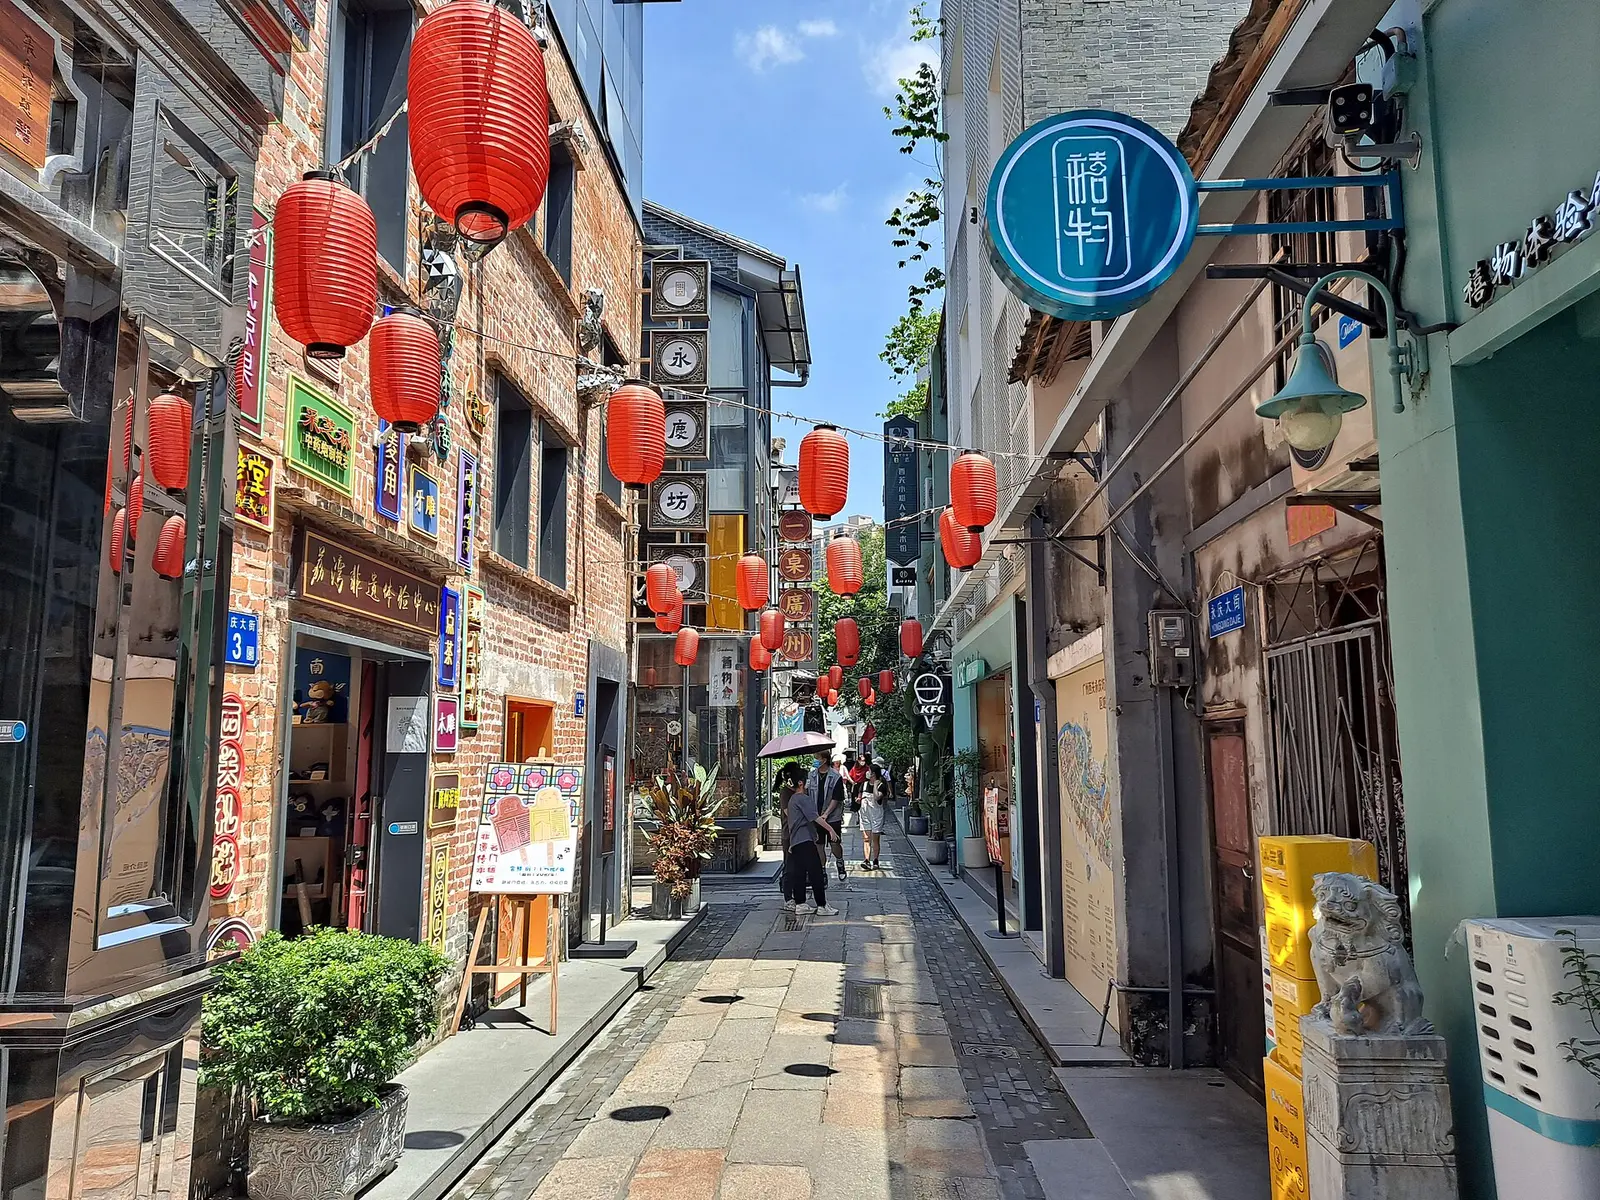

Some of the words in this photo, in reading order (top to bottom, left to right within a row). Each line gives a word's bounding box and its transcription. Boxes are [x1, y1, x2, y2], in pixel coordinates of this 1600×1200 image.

[301, 407, 352, 451] 采芝林
[414, 489, 437, 518] 牙雕
[1210, 593, 1240, 620] 永庆大街
[231, 632, 242, 660] 3
[444, 609, 455, 666] 点茶
[310, 658, 324, 675] 南
[920, 705, 946, 714] KFC
[437, 712, 456, 735] 木雕
